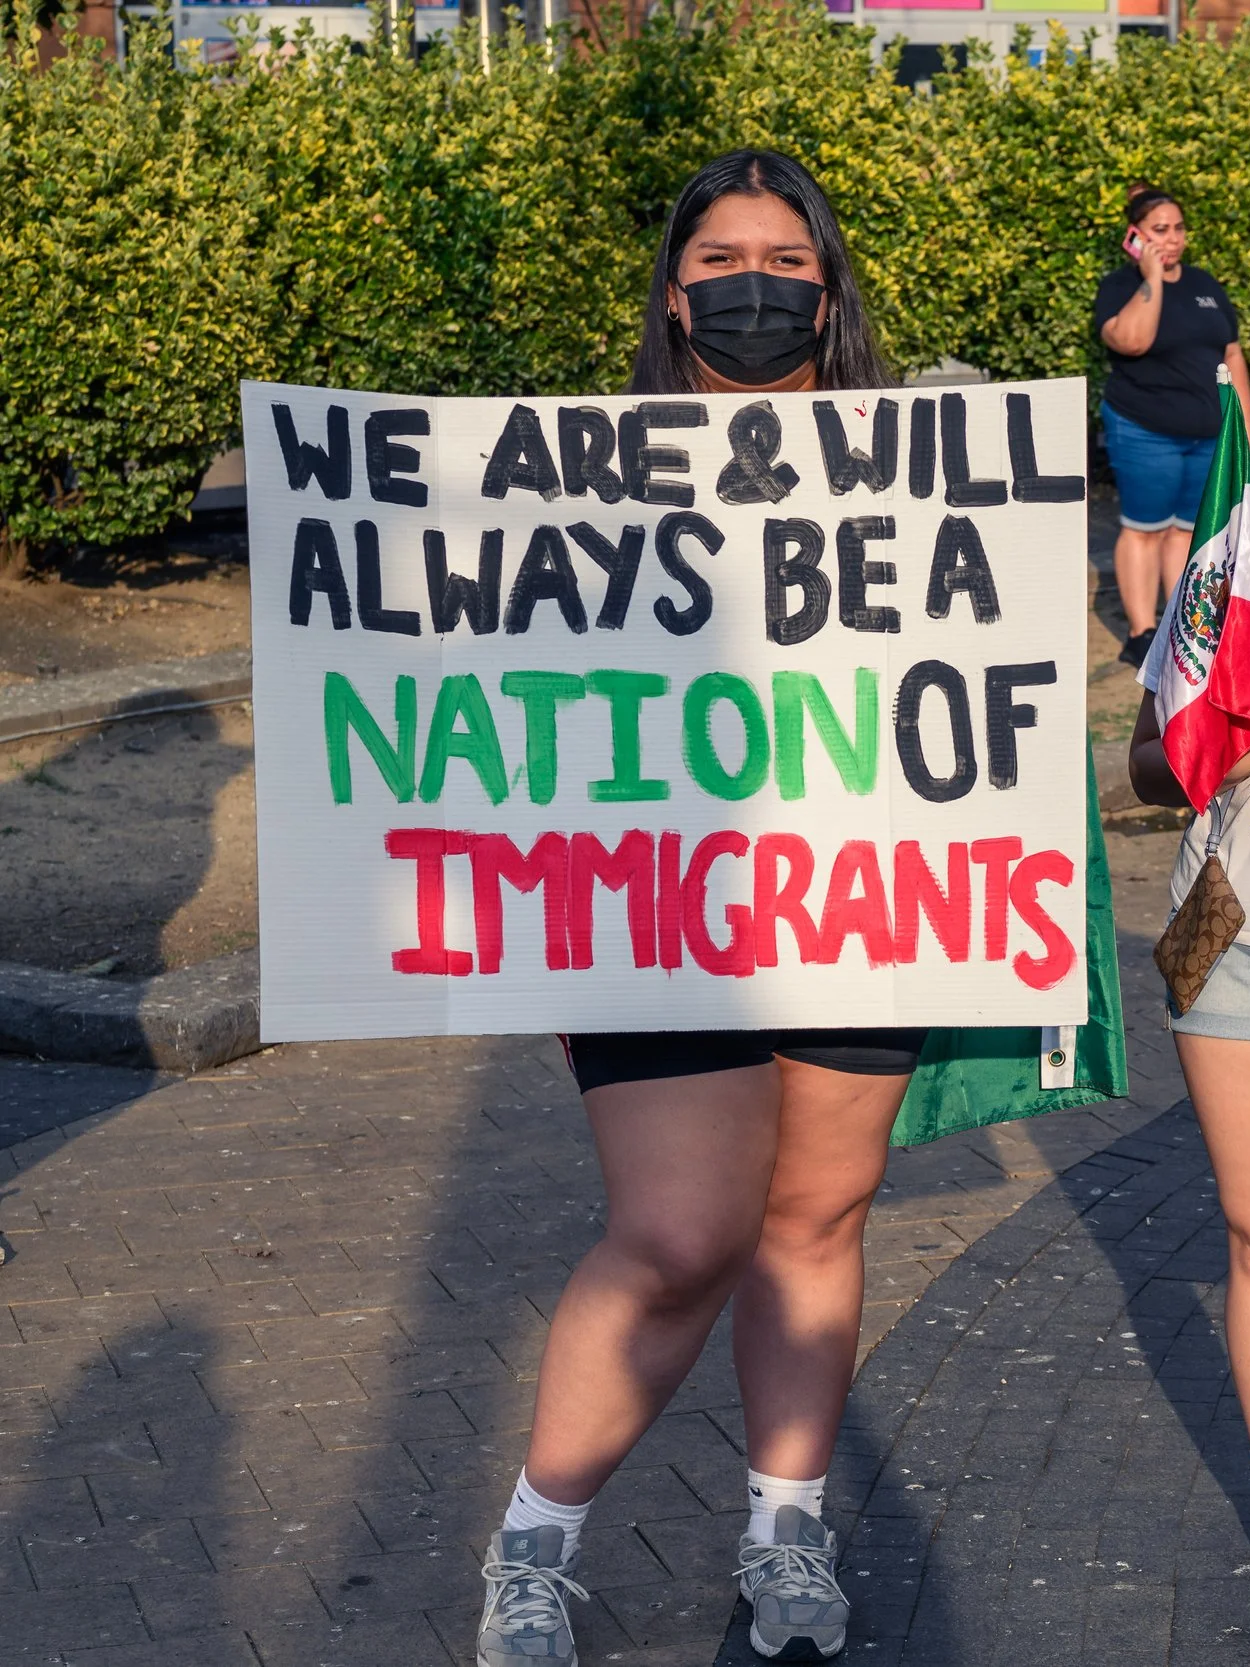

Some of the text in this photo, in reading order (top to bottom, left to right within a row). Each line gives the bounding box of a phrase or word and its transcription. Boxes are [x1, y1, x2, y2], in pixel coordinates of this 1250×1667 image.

[271, 392, 1086, 508] WE ARE & WILL
[289, 511, 1001, 646] ALWAYS BE A
[324, 659, 1058, 807] NATION OF
[384, 827, 1077, 991] IMMIGRANTS
